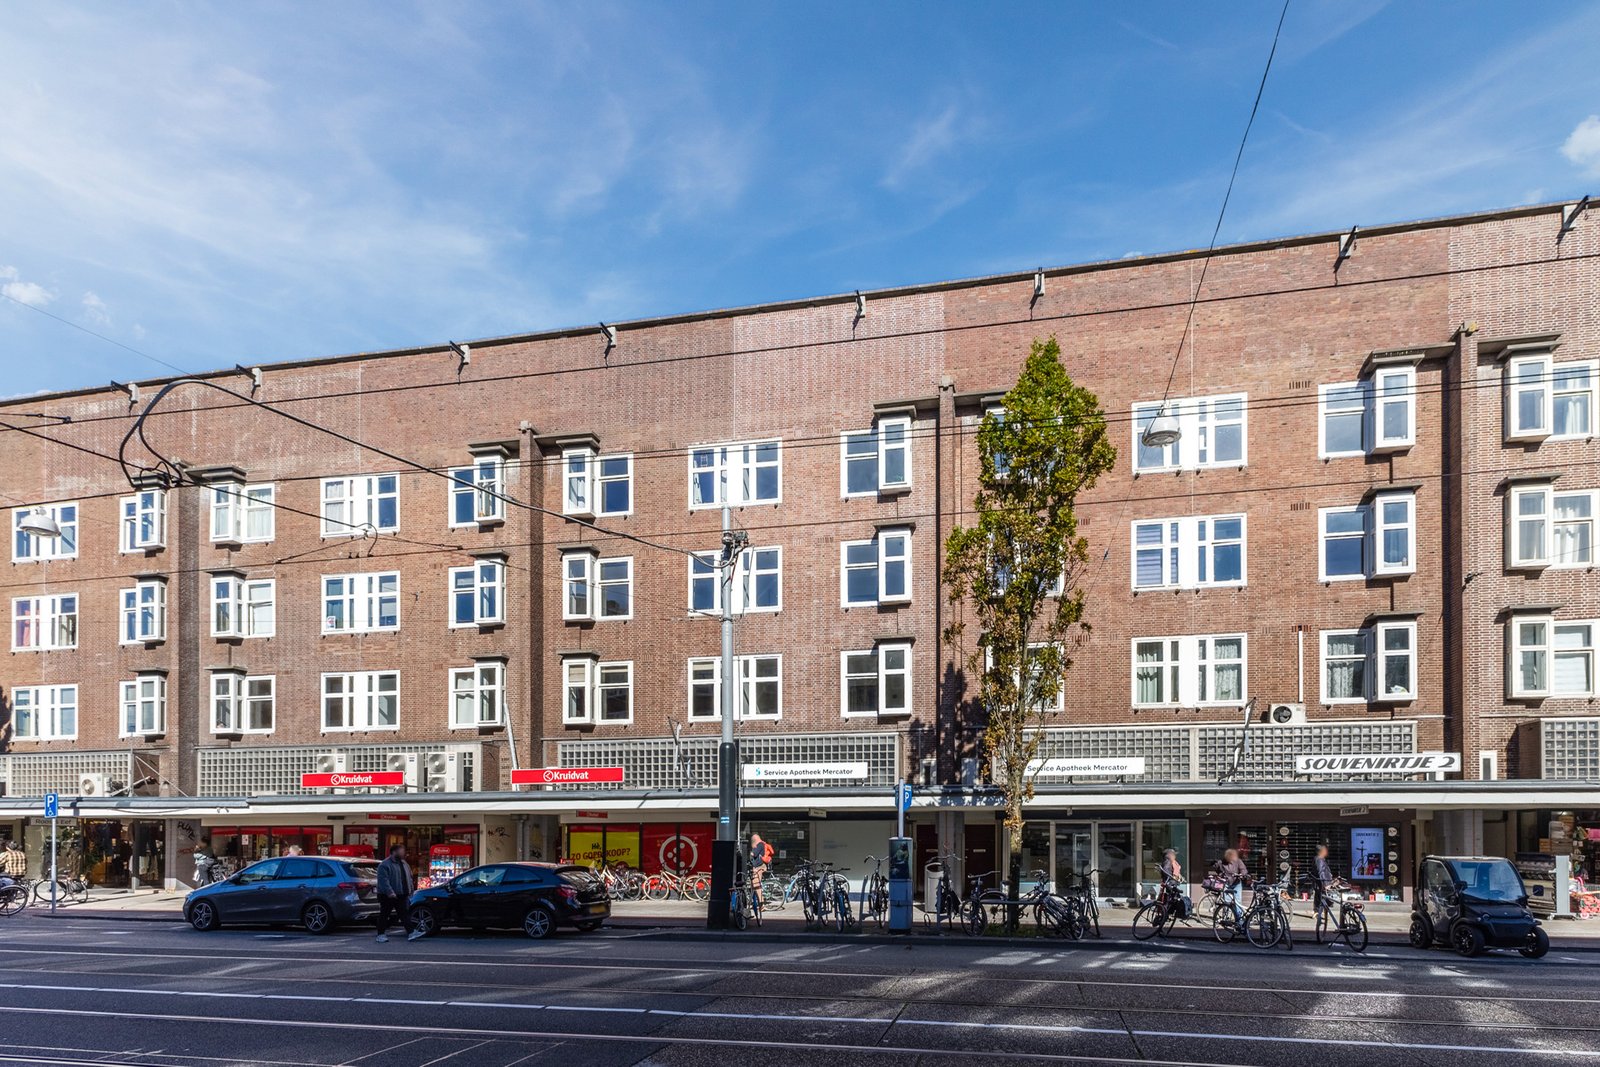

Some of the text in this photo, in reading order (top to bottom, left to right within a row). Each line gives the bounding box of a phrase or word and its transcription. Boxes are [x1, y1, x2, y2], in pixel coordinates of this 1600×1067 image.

[1301, 756, 1455, 770] SOUVENIRTJE 2
[789, 768, 821, 777] Apotheek
[1056, 764, 1092, 773] Apotheek
[340, 774, 373, 784] Kruidvat
[553, 770, 589, 780] Kruidvat
[47, 795, 55, 808] P
[905, 791, 910, 803] P
